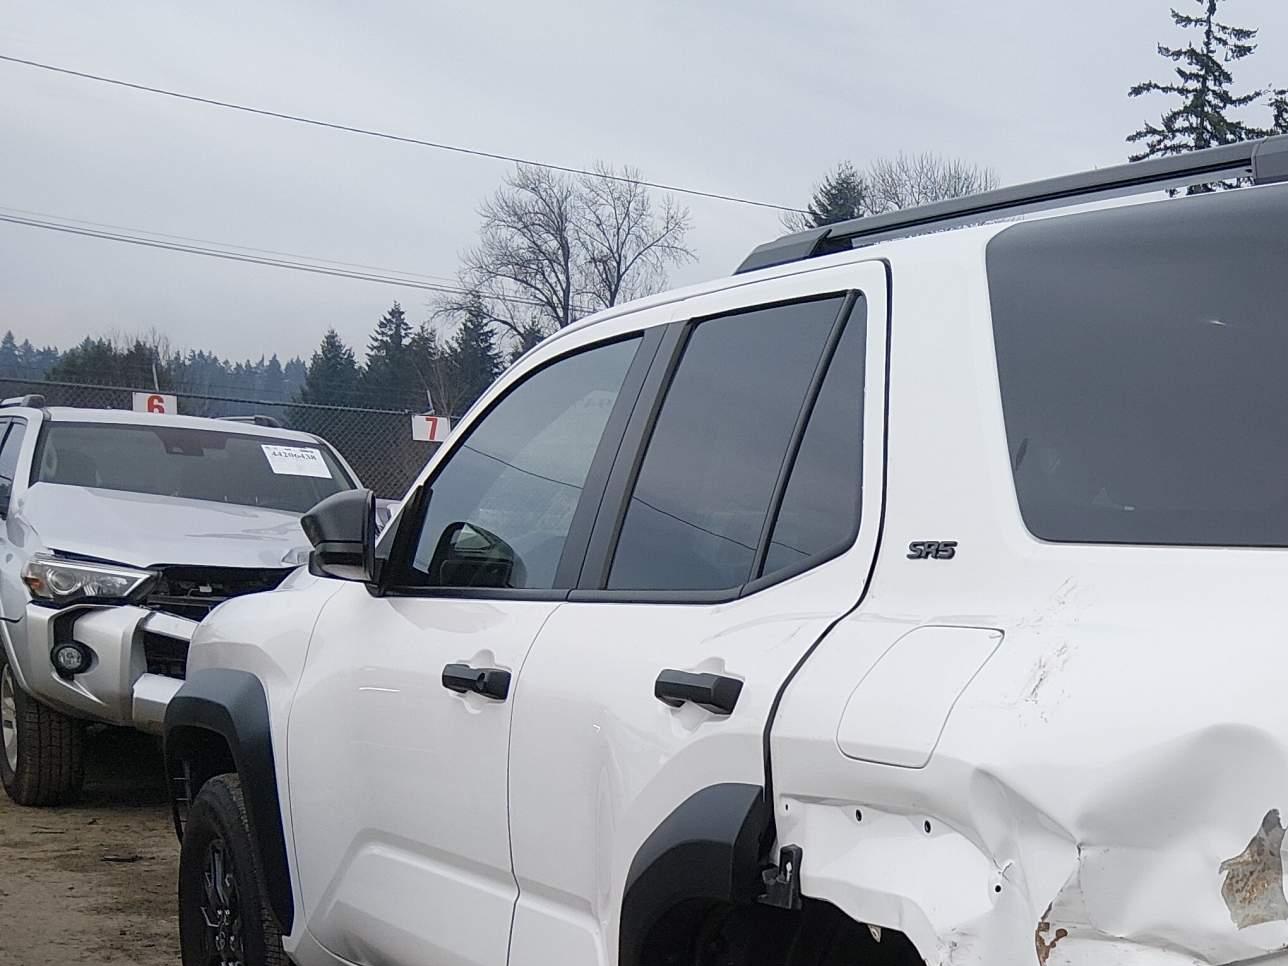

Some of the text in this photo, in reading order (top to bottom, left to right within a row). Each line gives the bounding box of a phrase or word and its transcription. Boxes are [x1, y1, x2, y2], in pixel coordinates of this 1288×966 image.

[147, 395, 165, 414] 6
[425, 417, 438, 440] 7
[906, 540, 958, 560] SR5
